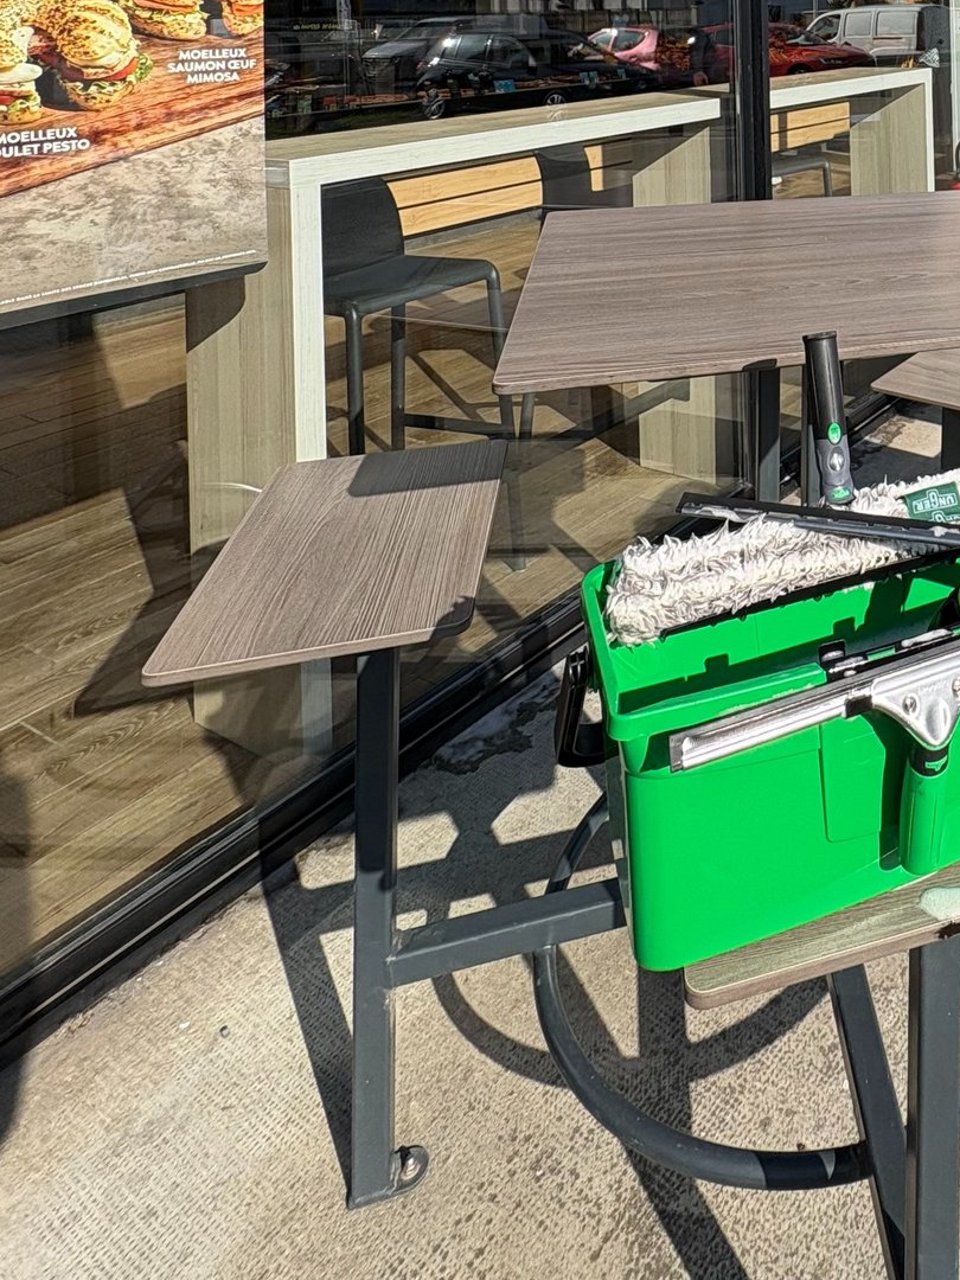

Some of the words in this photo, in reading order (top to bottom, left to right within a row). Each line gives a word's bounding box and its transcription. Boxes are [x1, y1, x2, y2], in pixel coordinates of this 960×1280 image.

[178, 48, 247, 60] MOELLEUX
[167, 61, 226, 73] SAUMON
[227, 59, 257, 70] ŒUF
[186, 71, 240, 84] MIMOSA
[43, 139, 90, 154] PESTO
[915, 491, 955, 511] UNGER
